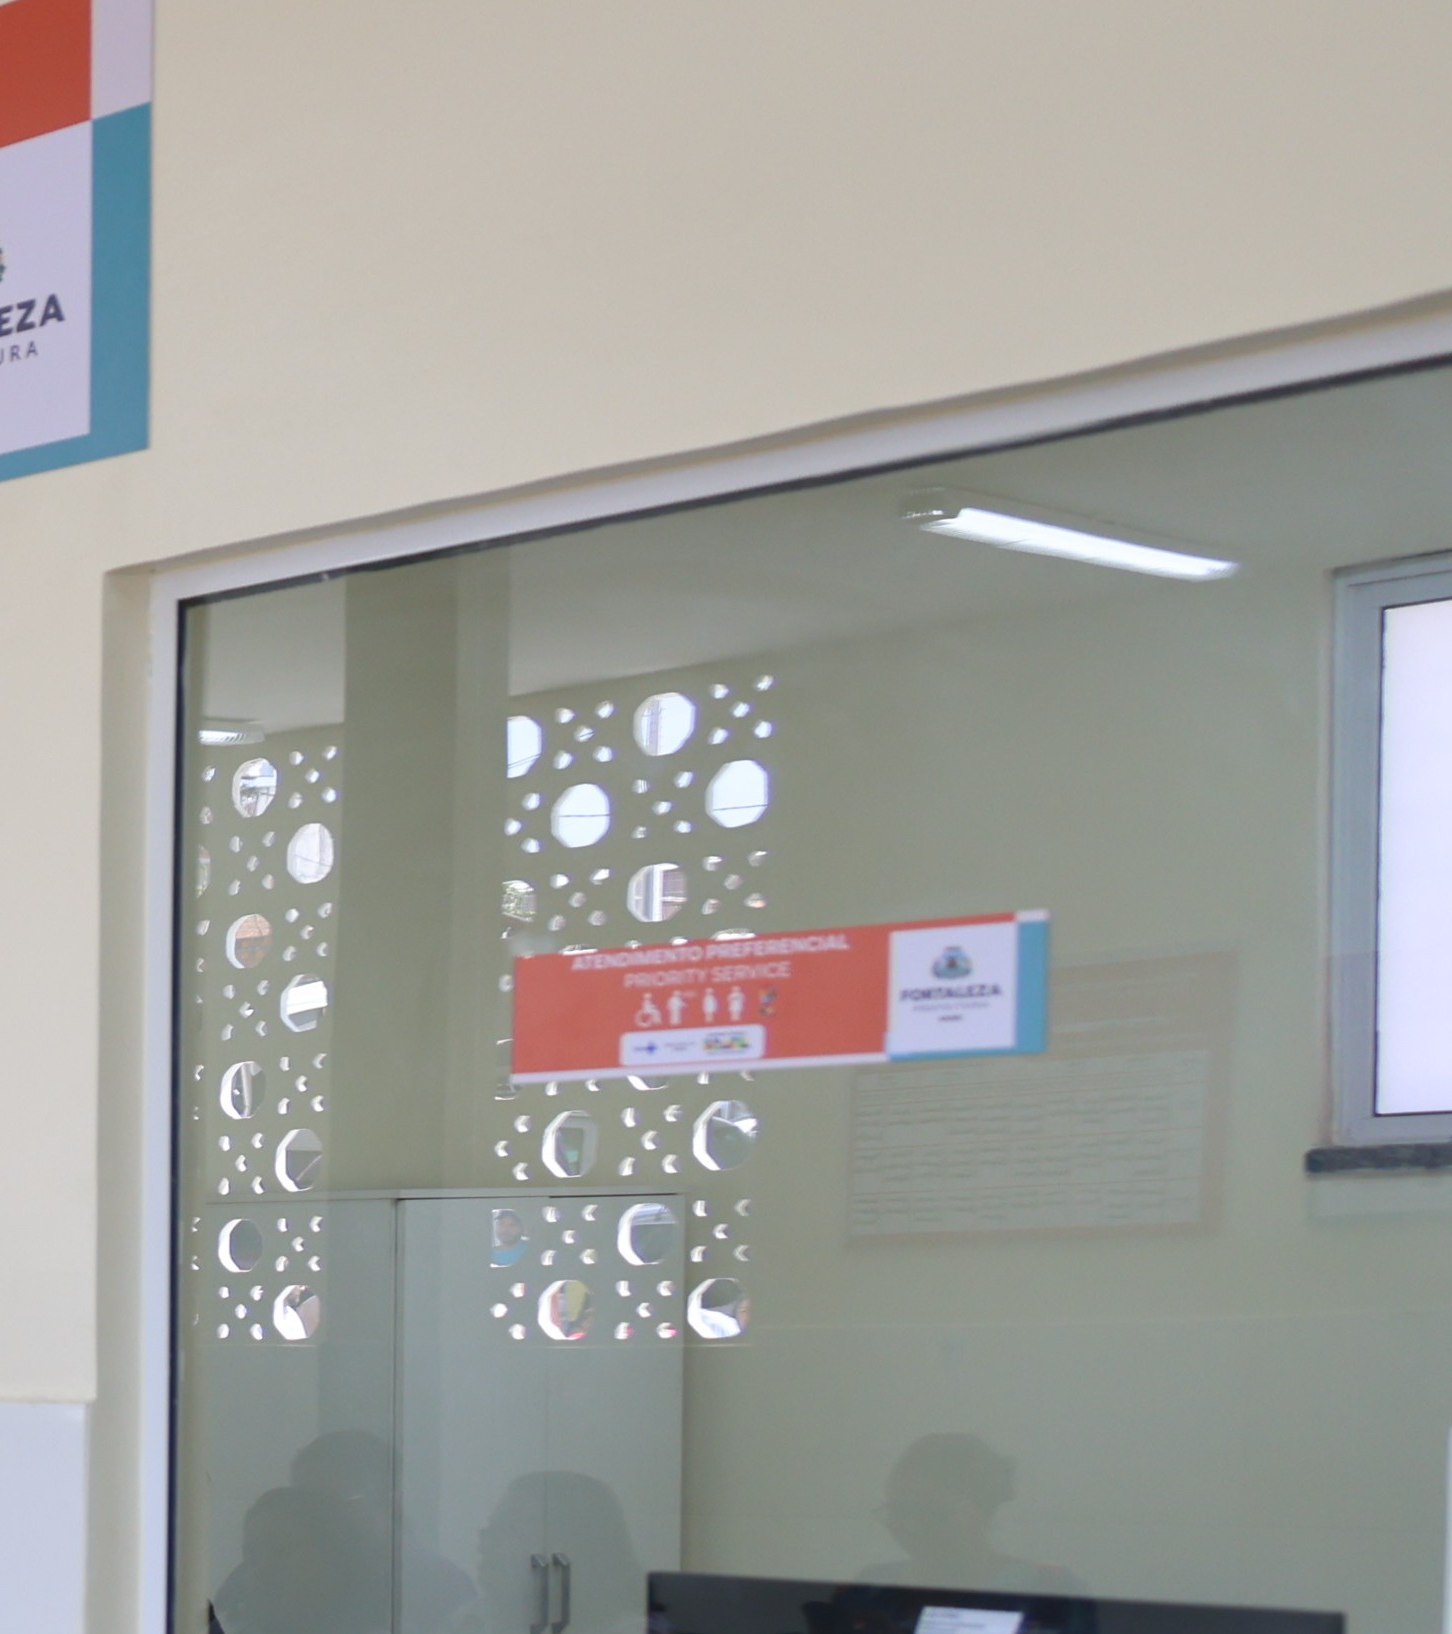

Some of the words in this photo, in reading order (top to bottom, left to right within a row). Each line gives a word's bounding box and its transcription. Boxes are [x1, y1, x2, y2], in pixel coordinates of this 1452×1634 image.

[571, 946, 704, 971] ATENDIMENTO
[705, 933, 851, 960] PREFERENCIAL
[623, 967, 706, 989] PRIORITY
[711, 960, 791, 983] SERVICE
[900, 984, 1003, 1001] FORTALEZA
